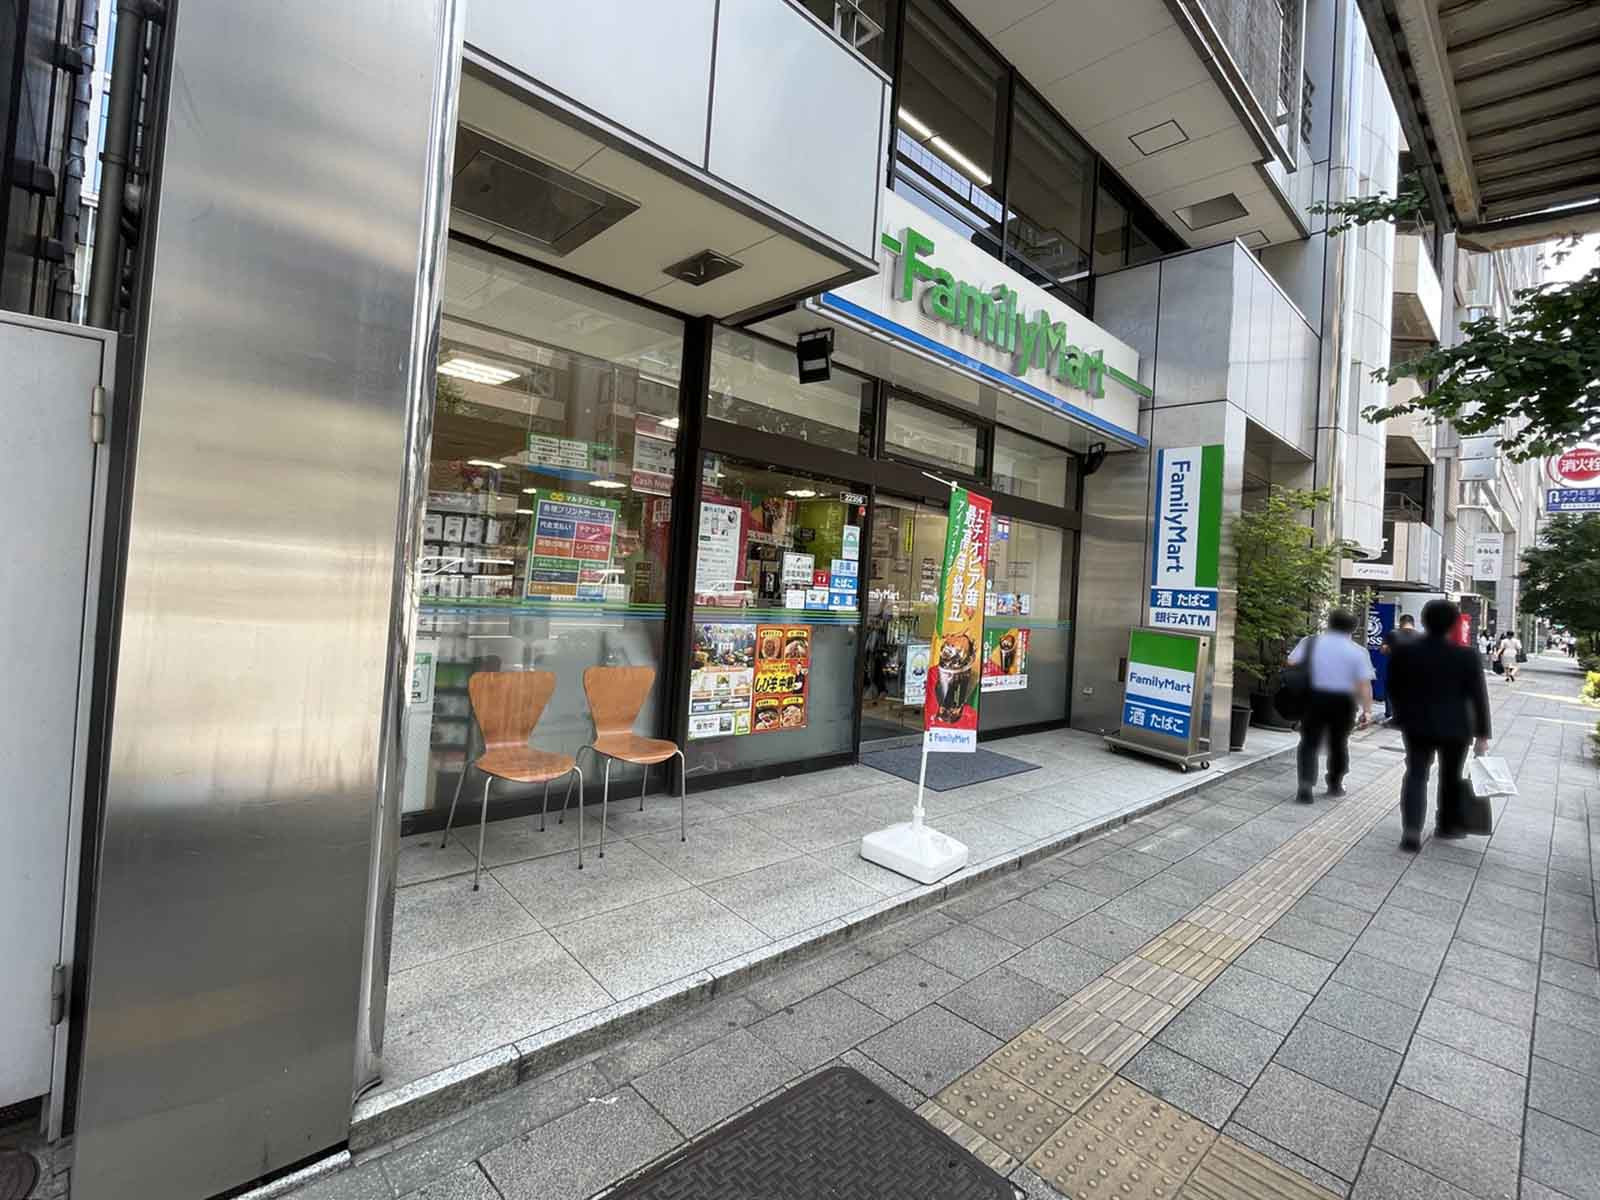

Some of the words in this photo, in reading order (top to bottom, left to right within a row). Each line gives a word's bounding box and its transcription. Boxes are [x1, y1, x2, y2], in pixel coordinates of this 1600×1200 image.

[894, 227, 1105, 399] FamilyMart
[1561, 458, 1600, 473] 消火栓
[1166, 459, 1191, 574] FamilyMart
[964, 508, 985, 606] エチオピア産
[834, 576, 853, 588] たばこ
[1156, 591, 1173, 608] 酒
[1177, 593, 1210, 608] たばこ
[1154, 611, 1210, 627] 銀行ATM
[1129, 672, 1191, 694] FamilyMart
[1129, 706, 1145, 728] 酒
[1150, 711, 1184, 734] たばこ
[934, 733, 970, 746] FamilyMart
